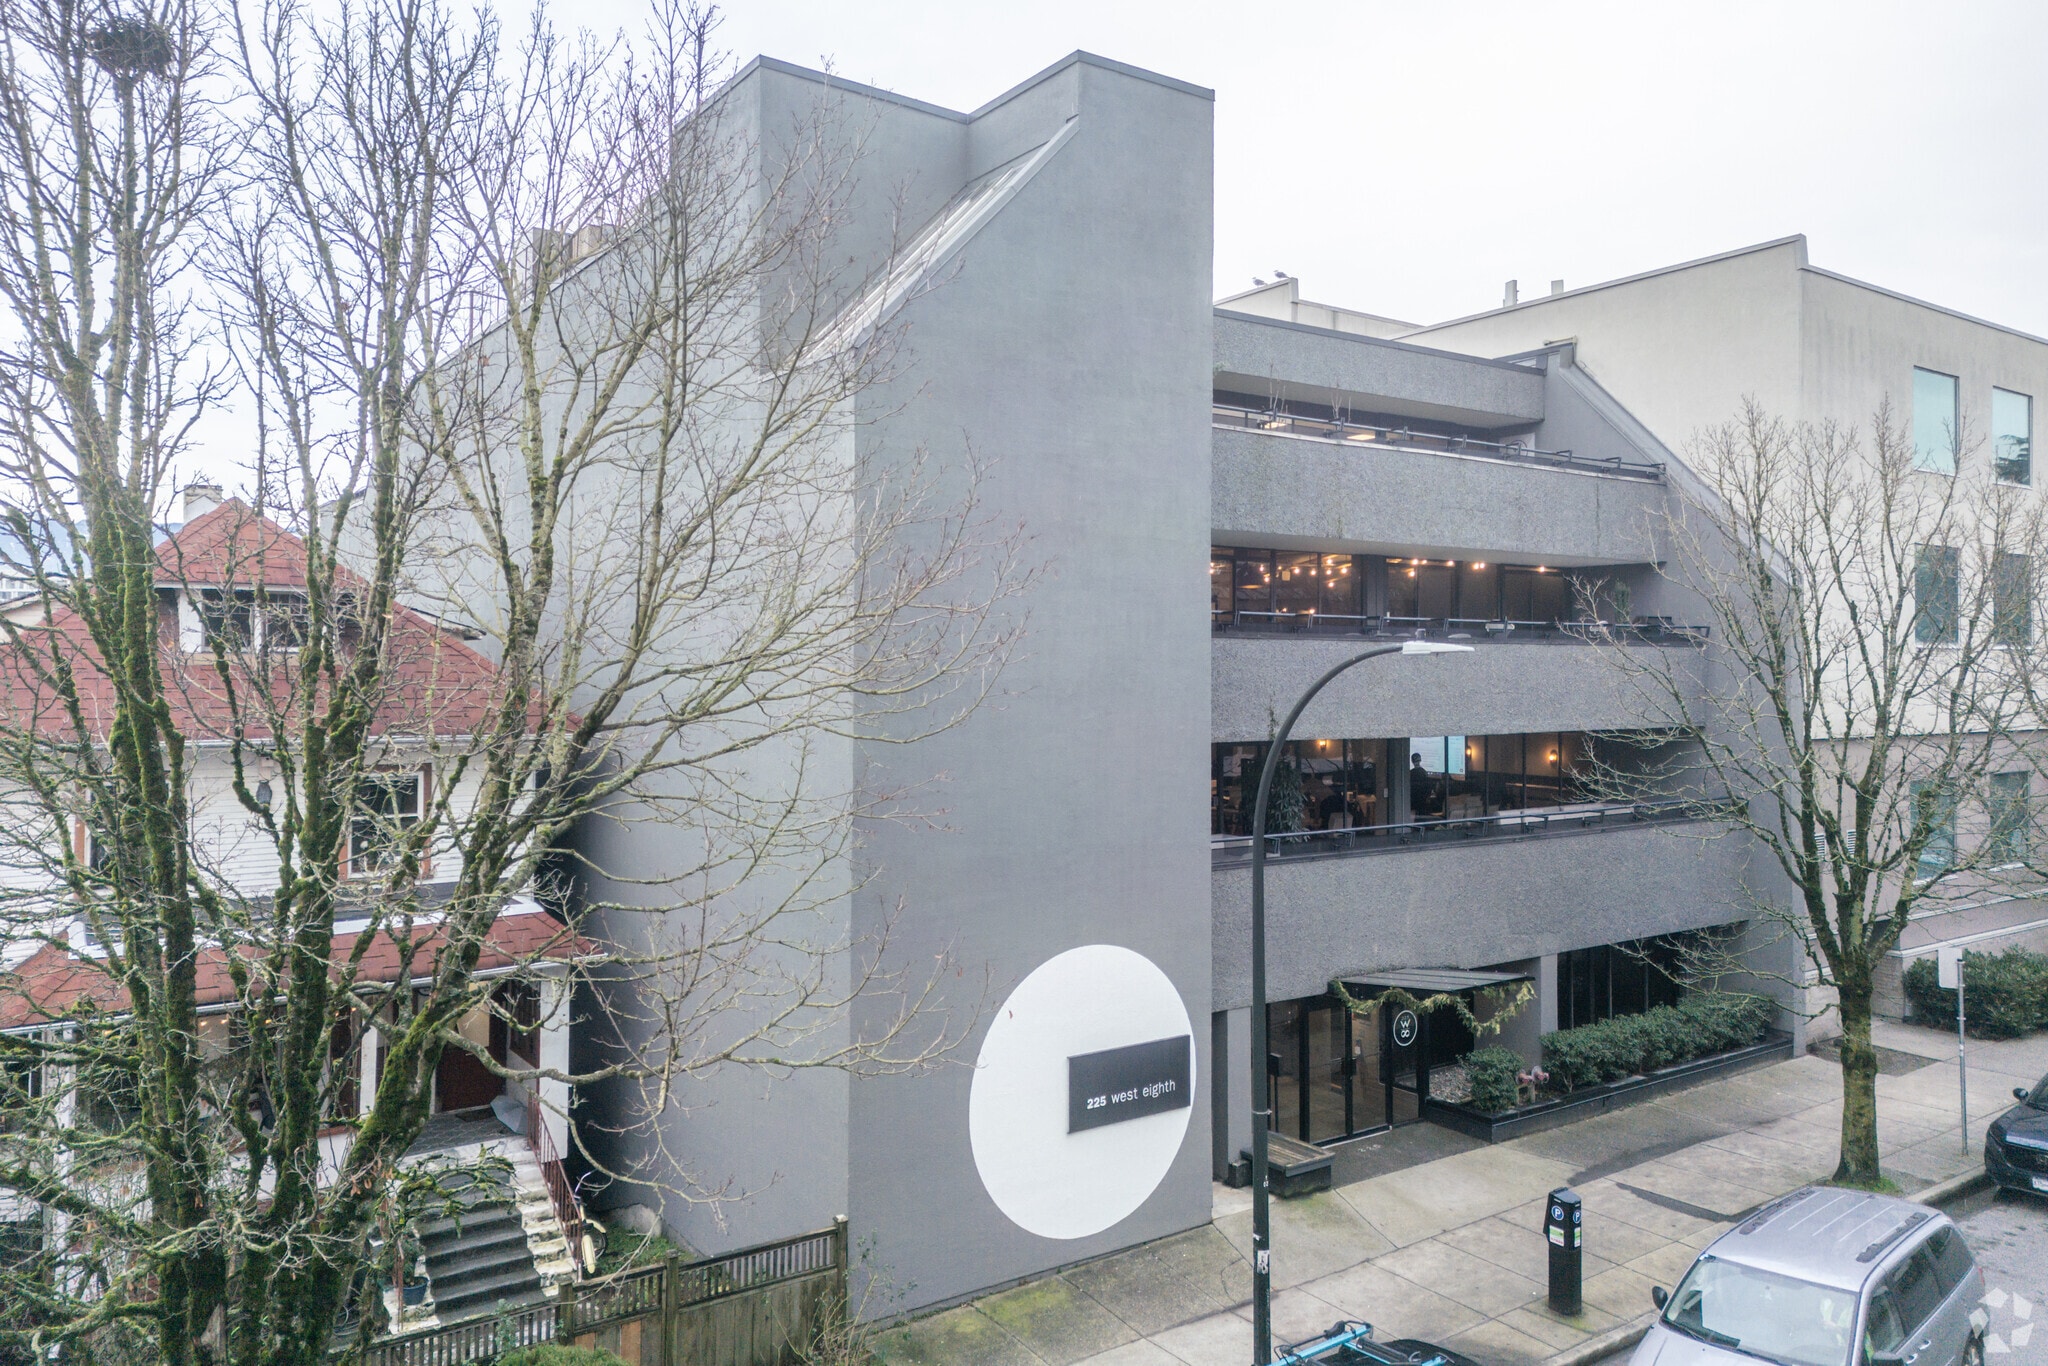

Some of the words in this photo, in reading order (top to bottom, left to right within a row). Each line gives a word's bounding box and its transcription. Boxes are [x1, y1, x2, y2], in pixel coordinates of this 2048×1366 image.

[1400, 1019, 1411, 1028] W
[1086, 1096, 1106, 1110] 225
[1111, 1088, 1138, 1104] west
[1142, 1080, 1176, 1098] eighth
